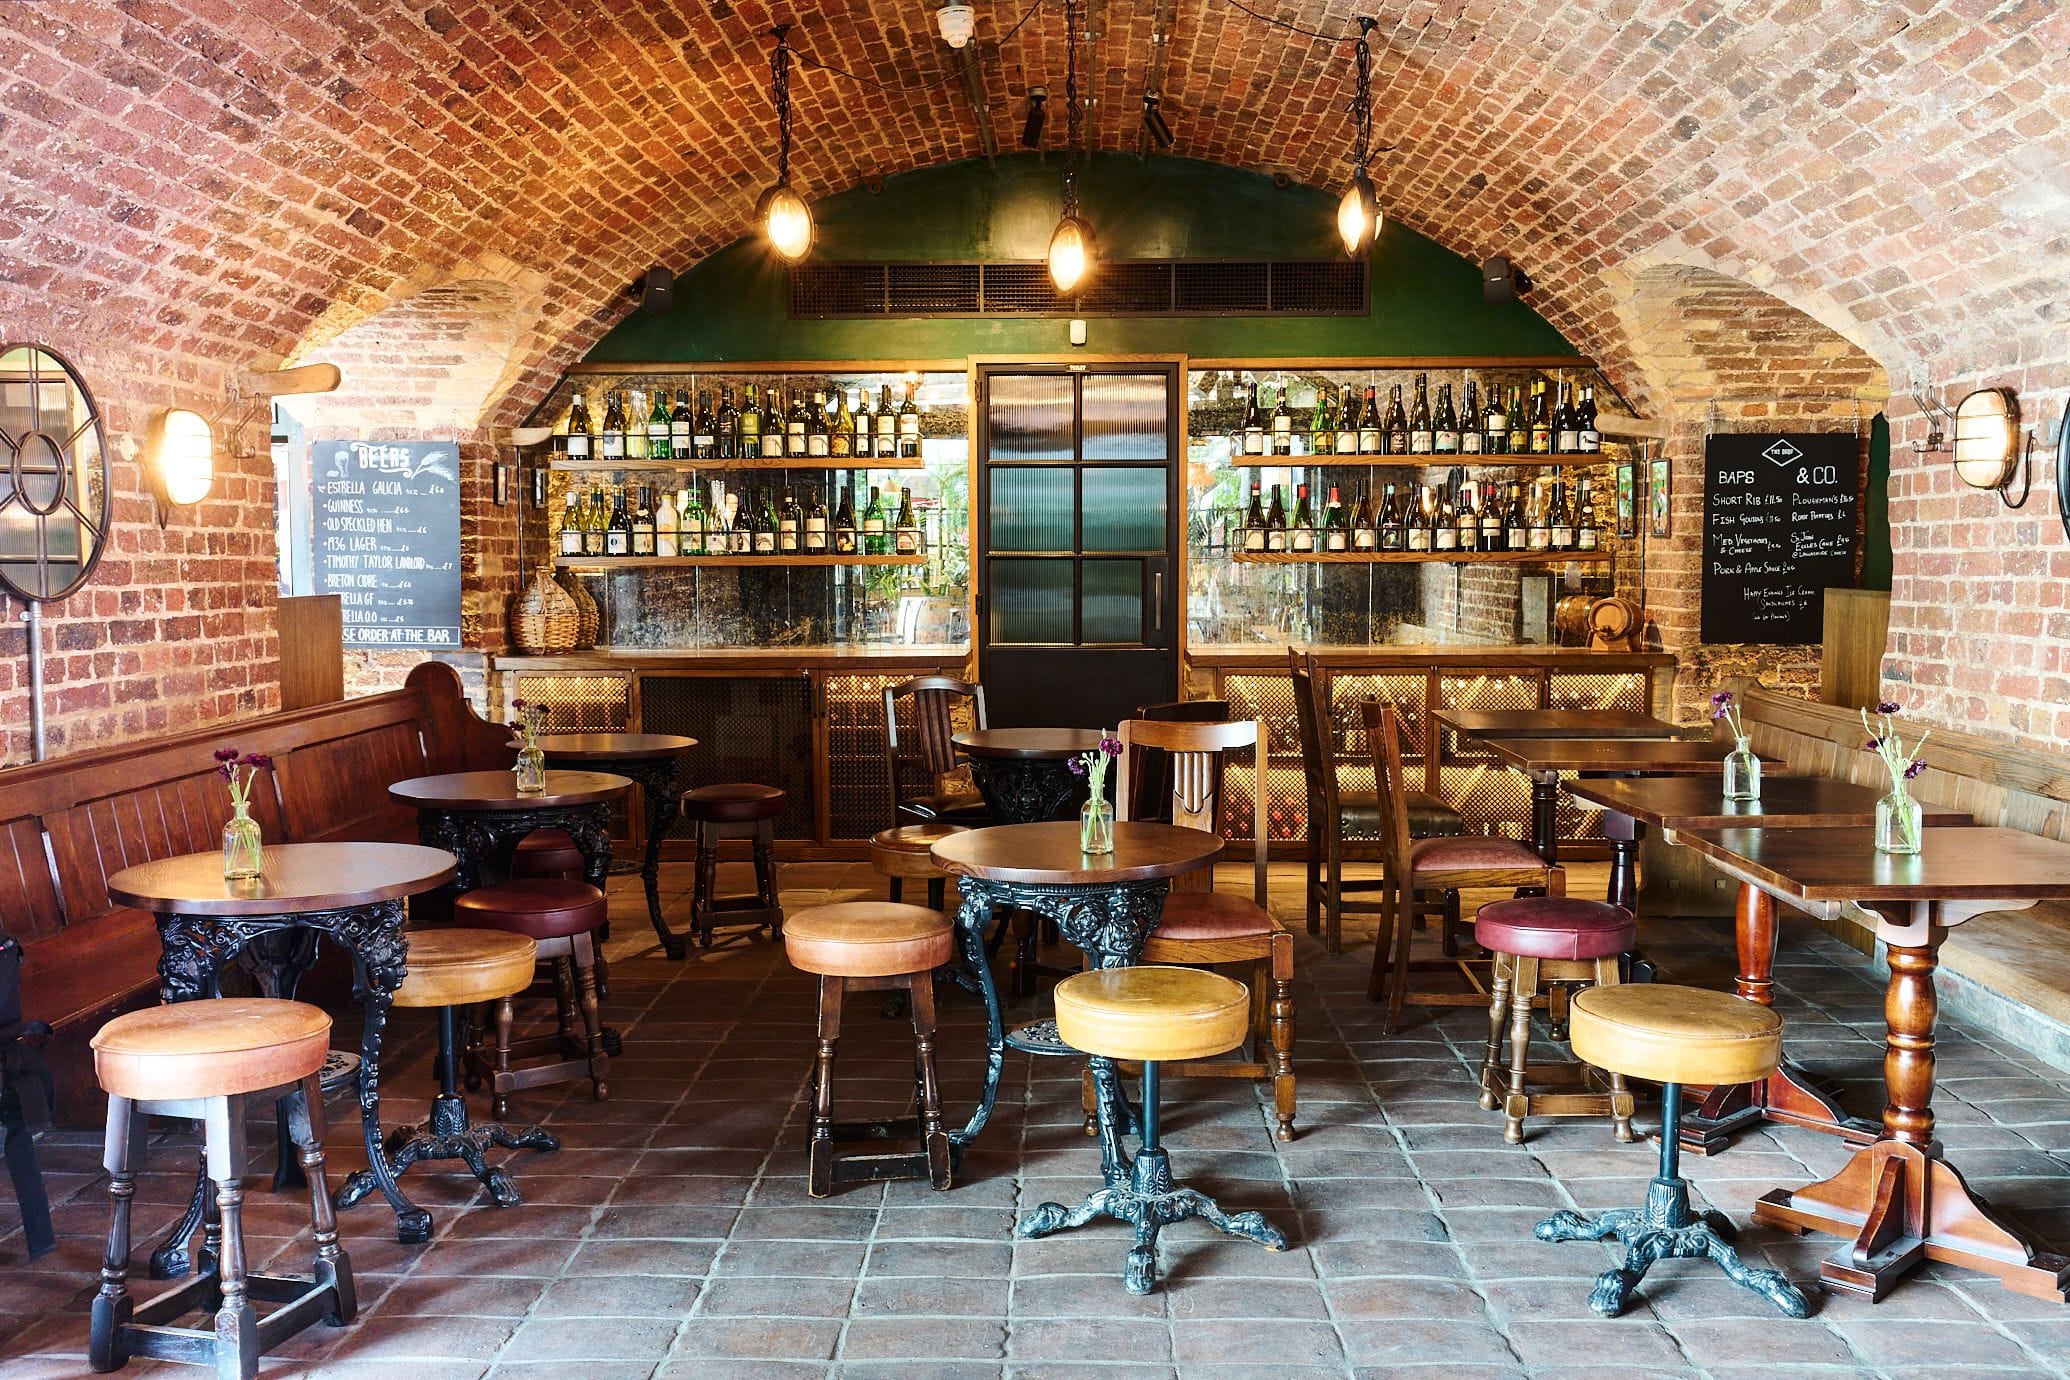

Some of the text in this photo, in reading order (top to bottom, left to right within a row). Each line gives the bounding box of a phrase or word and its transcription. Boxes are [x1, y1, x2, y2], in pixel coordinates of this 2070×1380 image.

[358, 447, 410, 469] BEERS
[1718, 470, 1755, 484] BAPS
[1796, 465, 1838, 484] & CO.
[327, 480, 366, 495] ESTRELLA
[372, 480, 402, 495] GALICIA
[327, 499, 364, 514] GUINNESS
[1712, 493, 1743, 506] SHORT
[1745, 492, 1761, 506] RIB
[327, 517, 340, 531] OLD
[340, 516, 376, 532] SPECKLED
[376, 518, 392, 533] HEN
[1712, 513, 1735, 526] FISH
[327, 536, 346, 551] 1936
[349, 536, 377, 551] LAGER
[326, 554, 359, 569] TIMOTHY
[363, 554, 393, 570] TAYLOR
[1713, 561, 1735, 576] PORK
[327, 573, 355, 588] BRETON
[364, 591, 374, 606] GF
[341, 608, 364, 623] RELLA
[357, 628, 389, 641] ORDER
[389, 628, 401, 641] AT
[403, 628, 424, 642] THE
[427, 629, 450, 643] BAR
